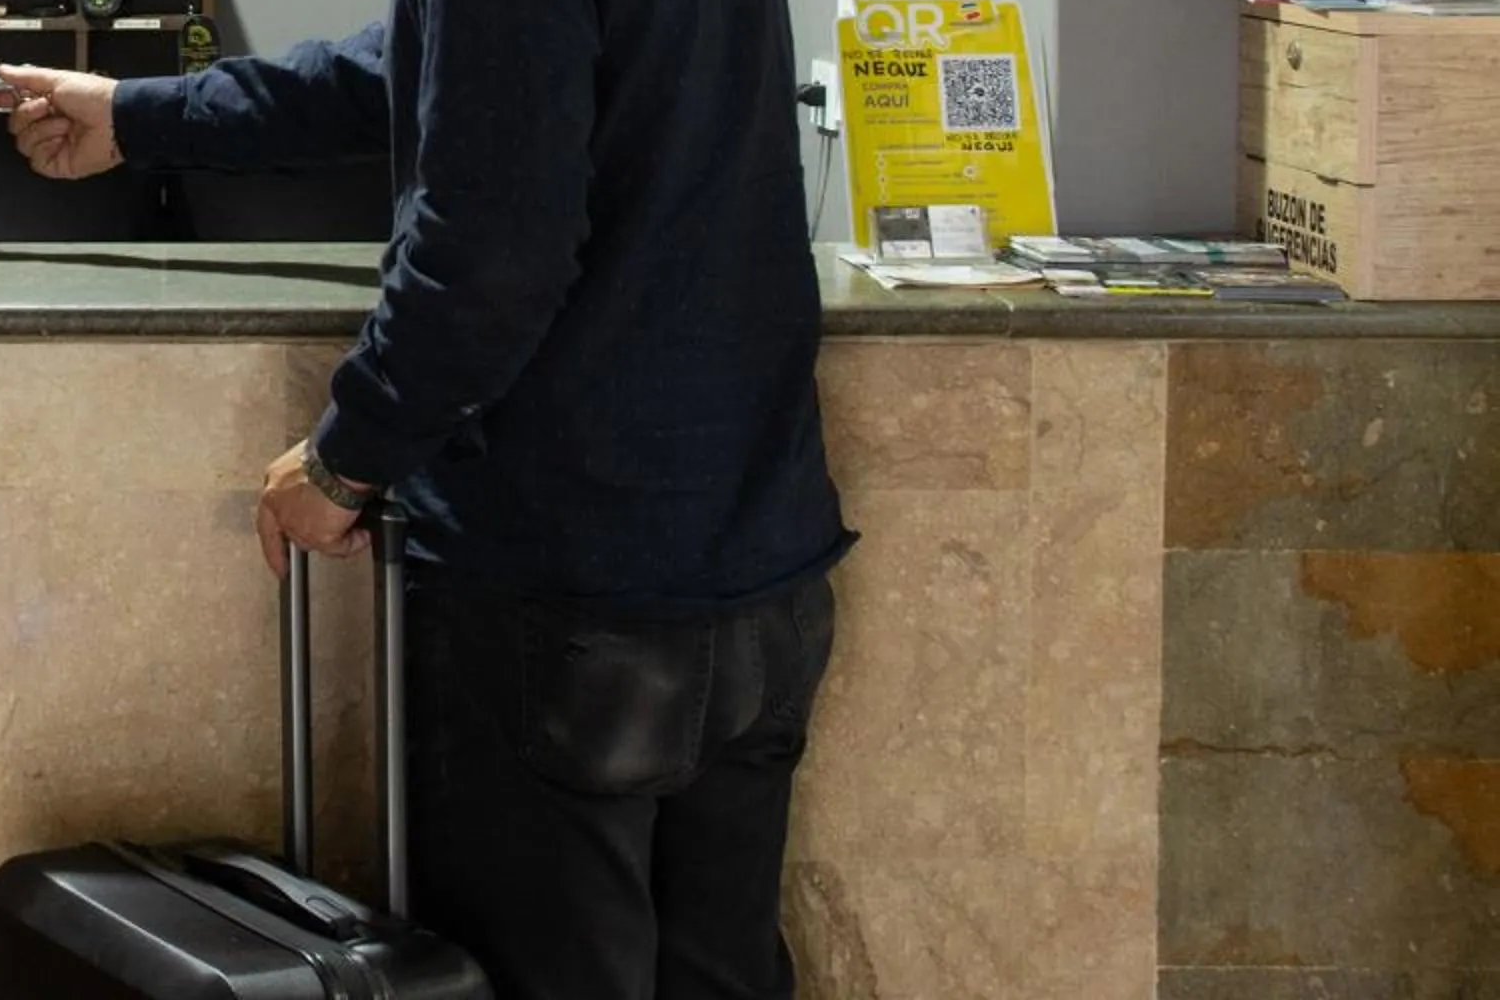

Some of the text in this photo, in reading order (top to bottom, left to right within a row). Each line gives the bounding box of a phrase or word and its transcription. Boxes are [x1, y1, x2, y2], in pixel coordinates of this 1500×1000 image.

[860, 3, 949, 49] QR
[853, 61, 929, 78] NEQUI
[1310, 201, 1325, 235] DE
